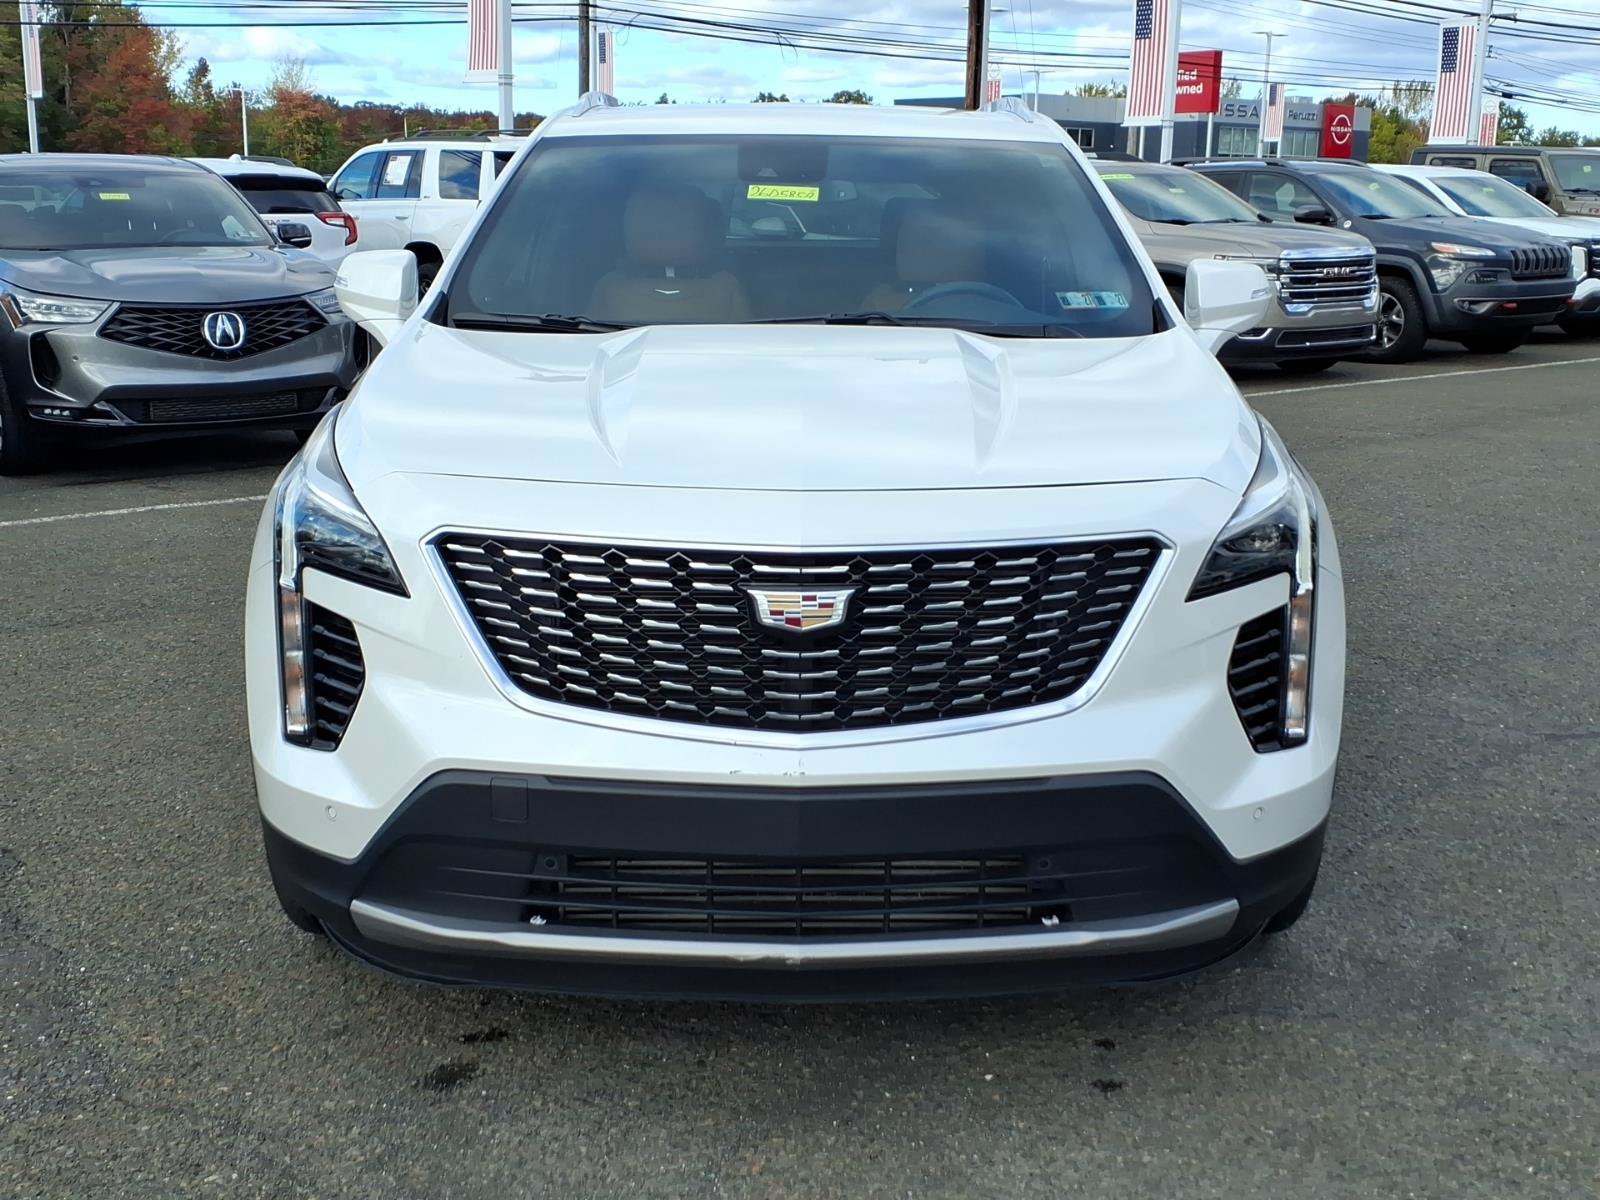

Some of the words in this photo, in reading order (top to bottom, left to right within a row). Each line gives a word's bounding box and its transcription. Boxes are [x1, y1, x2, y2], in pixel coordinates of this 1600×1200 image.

[1177, 68, 1197, 80] fied
[1175, 82, 1203, 94] wned
[1220, 103, 1259, 119] ISSA
[1288, 110, 1318, 121] Peruzzi
